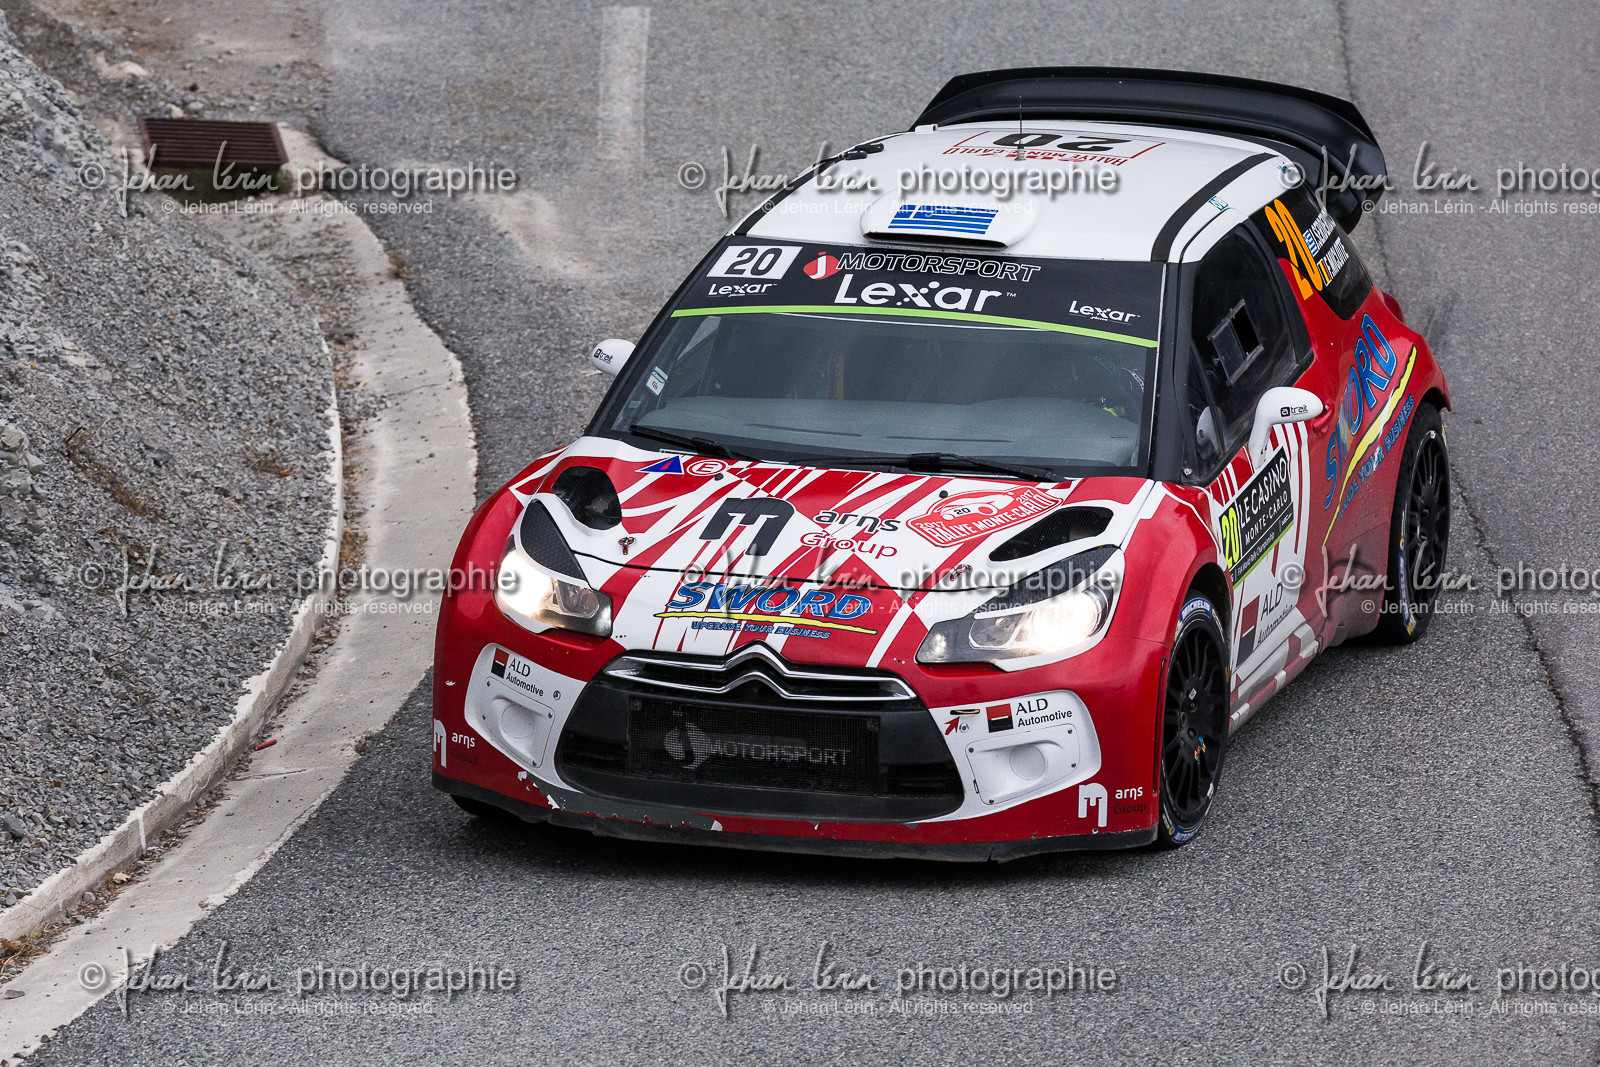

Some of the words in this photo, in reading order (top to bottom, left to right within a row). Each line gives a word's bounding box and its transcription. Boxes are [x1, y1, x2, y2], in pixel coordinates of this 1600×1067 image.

[724, 247, 783, 276] 20
[1264, 198, 1323, 301] 20
[836, 252, 1041, 282] MOTORSPORT
[1384, 393, 1415, 456] BUSINESS
[1016, 489, 1035, 504] 2017
[1238, 496, 1251, 529] LE
[1251, 457, 1288, 515] CASINO
[923, 521, 978, 544] RALLYE
[972, 493, 1056, 534] MONTE-CARLO
[954, 506, 972, 515] 20
[800, 532, 898, 560] Group
[1221, 506, 1240, 570] 20
[665, 581, 873, 620] SWORD
[1260, 582, 1284, 622] ALD
[692, 620, 742, 632] UPGRADE
[743, 622, 774, 634] YOUR
[774, 626, 832, 640] BUSINESS
[508, 657, 531, 677] ALD
[506, 672, 544, 697] Automotive
[1015, 698, 1049, 716] ALD
[1017, 709, 1073, 728] Automotive
[450, 749, 479, 767] Group
[1113, 802, 1148, 815] Group
